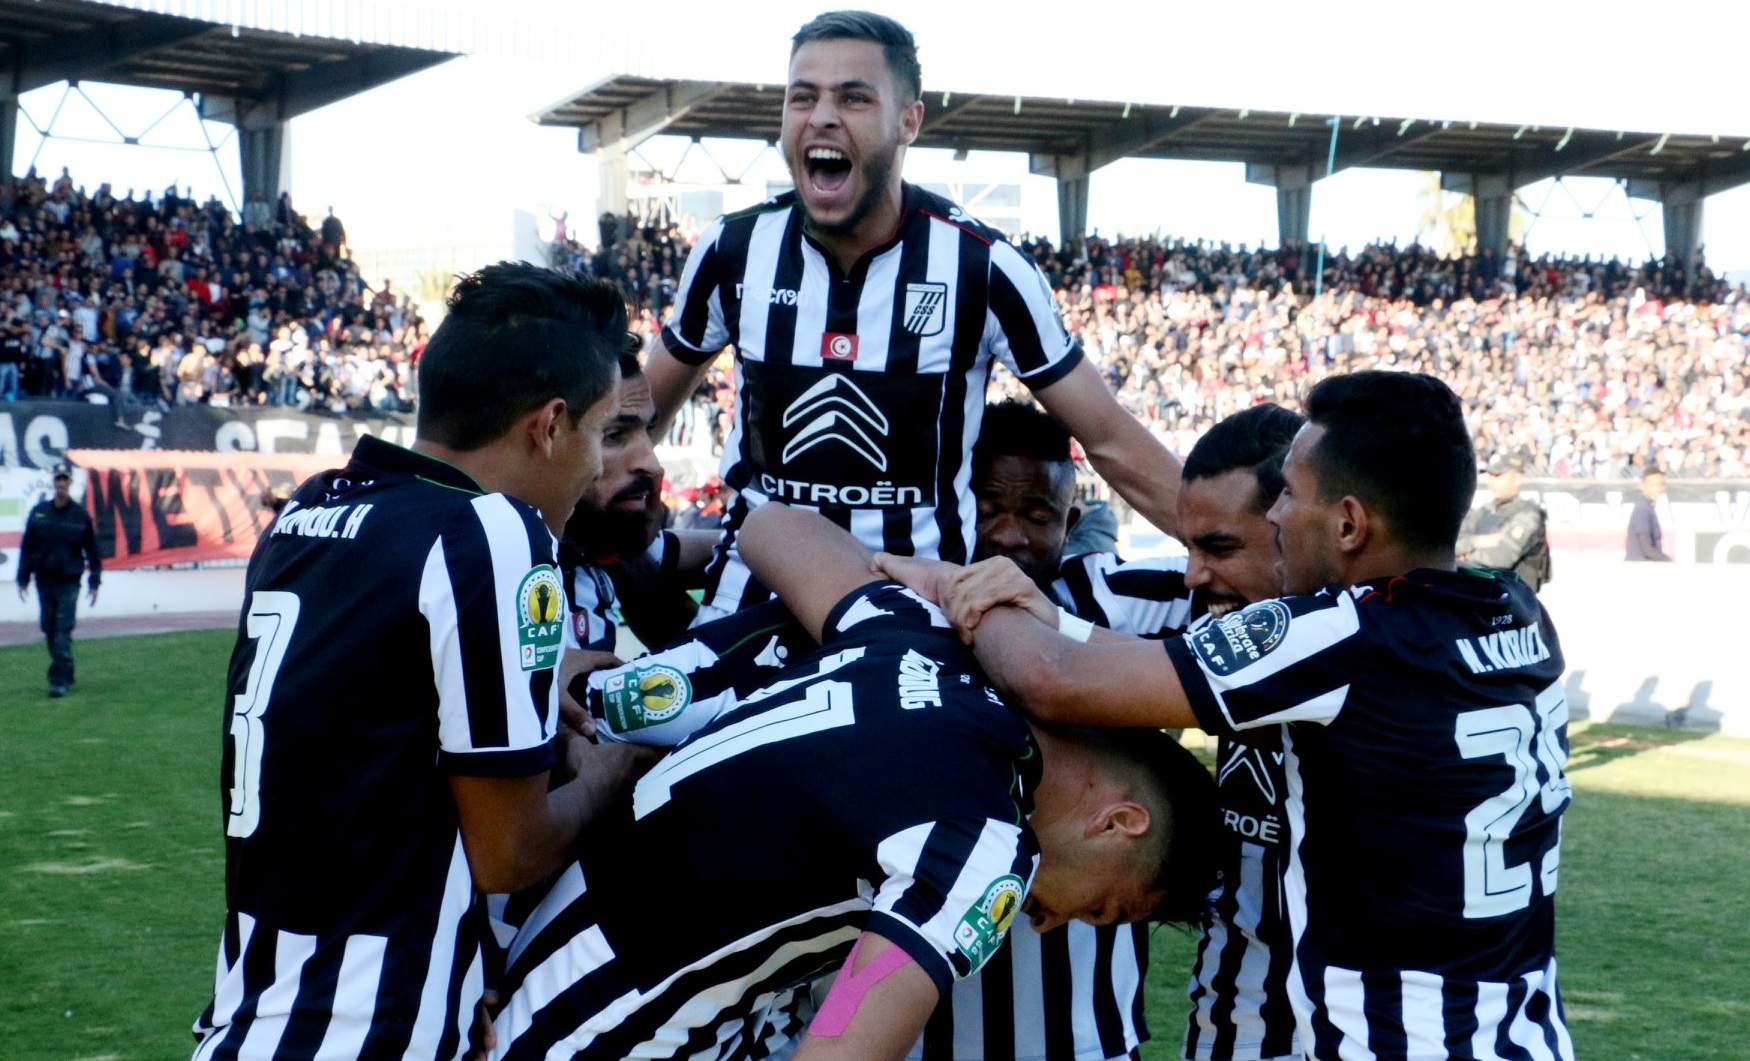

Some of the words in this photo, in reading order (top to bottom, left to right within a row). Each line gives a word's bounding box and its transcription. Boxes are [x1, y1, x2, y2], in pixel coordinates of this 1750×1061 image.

[913, 305, 935, 316] CSS
[527, 624, 557, 638] CAF
[1199, 632, 1226, 666] CAF
[628, 678, 642, 716] CAF
[1221, 807, 1281, 844] ROË
